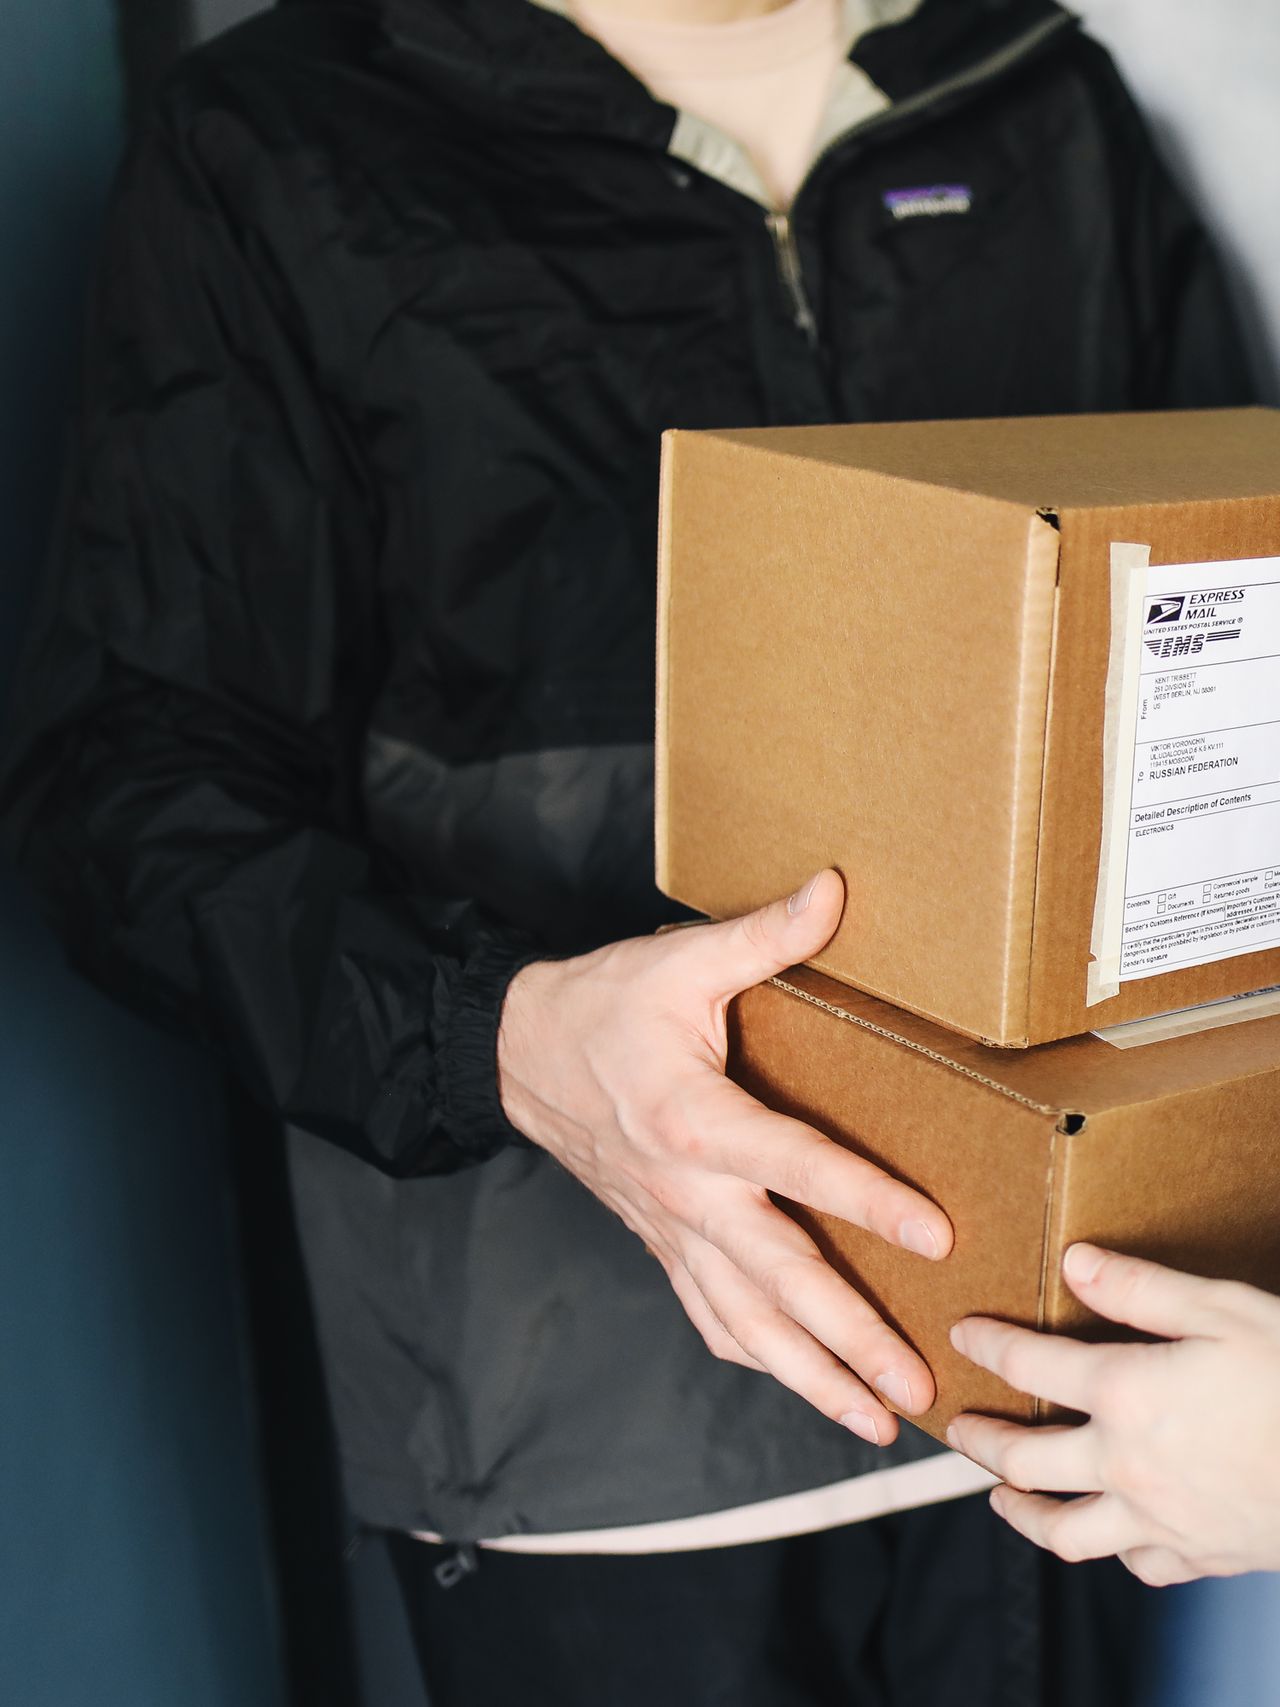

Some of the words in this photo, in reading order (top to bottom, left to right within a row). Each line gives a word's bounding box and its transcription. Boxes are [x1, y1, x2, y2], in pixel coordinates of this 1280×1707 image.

[1190, 589, 1246, 605] EXPRESS
[1185, 607, 1217, 620] MAIL
[1144, 626, 1167, 635] UNITED
[1167, 623, 1188, 632] STATES
[1188, 620, 1211, 630] POSTAL
[1212, 618, 1236, 627] SERVICE
[1160, 633, 1205, 658] EMS
[1154, 676, 1170, 685] KENT
[1188, 680, 1196, 688] ST
[1153, 692, 1170, 701] WEST
[1193, 688, 1200, 696] NJ
[1140, 699, 1148, 720] From
[1153, 702, 1160, 710] US
[1150, 742, 1172, 752] VIKTOR
[1168, 755, 1196, 766] MOSCOW
[1150, 766, 1186, 780] RUSSIAN
[1187, 757, 1239, 774] FEDERATION
[1134, 809, 1165, 823] Detailed
[1166, 802, 1209, 817] Description
[1210, 798, 1219, 808] of
[1220, 793, 1252, 806] Contents
[1135, 824, 1175, 838] ELECTRONICS
[1213, 878, 1240, 890] Commercial
[1214, 888, 1234, 900] Returned
[1235, 887, 1250, 897] goods
[1126, 900, 1151, 910] Contents
[1168, 900, 1195, 911] Documents
[1226, 899, 1252, 910] Importer's
[1252, 894, 1275, 904] Customs
[1258, 902, 1277, 912] known)
[1125, 923, 1149, 934] Sender's
[1150, 918, 1173, 928] Customs
[1174, 912, 1200, 922] Reference
[1206, 906, 1226, 915] known)
[1160, 933, 1186, 943] particulars
[1186, 930, 1200, 938] given
[1214, 922, 1234, 930] customs
[1234, 914, 1260, 925] declaration
[1124, 948, 1150, 958] dangerous
[1168, 938, 1192, 948] prohibited
[1256, 919, 1275, 928] customs
[1122, 958, 1146, 968] Sender's
[1146, 953, 1168, 964] signature
